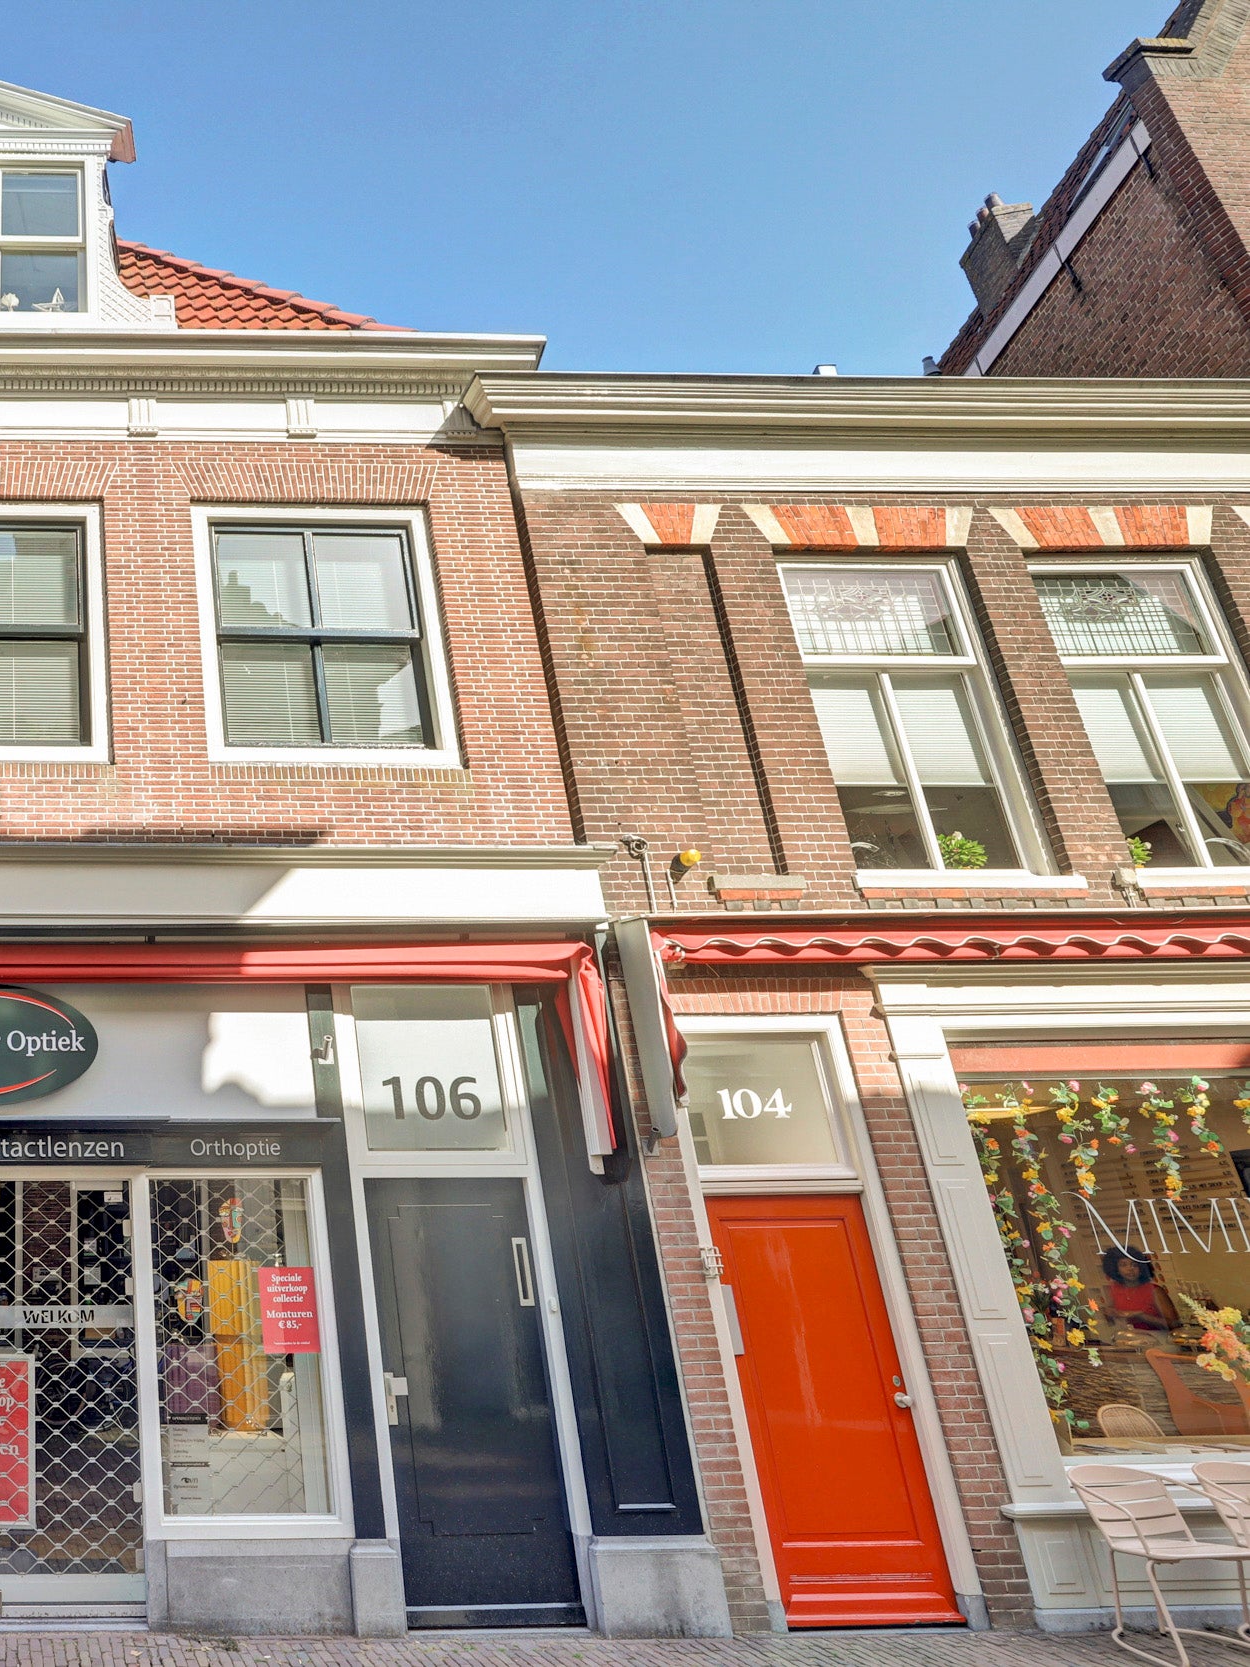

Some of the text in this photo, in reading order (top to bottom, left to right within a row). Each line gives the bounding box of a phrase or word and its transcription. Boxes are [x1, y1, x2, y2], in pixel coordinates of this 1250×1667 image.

[6, 1029, 85, 1057] Optiek
[382, 1076, 482, 1121] 106
[716, 1087, 793, 1120] 104
[190, 1138, 281, 1161] Orthoptie
[1060, 1191, 1250, 1264] MIMI
[271, 1273, 302, 1284] Speciale
[267, 1284, 308, 1295] uitverkoop
[273, 1293, 304, 1303] collectie
[23, 1310, 95, 1324] WELKOM
[266, 1310, 313, 1319] Monturen
